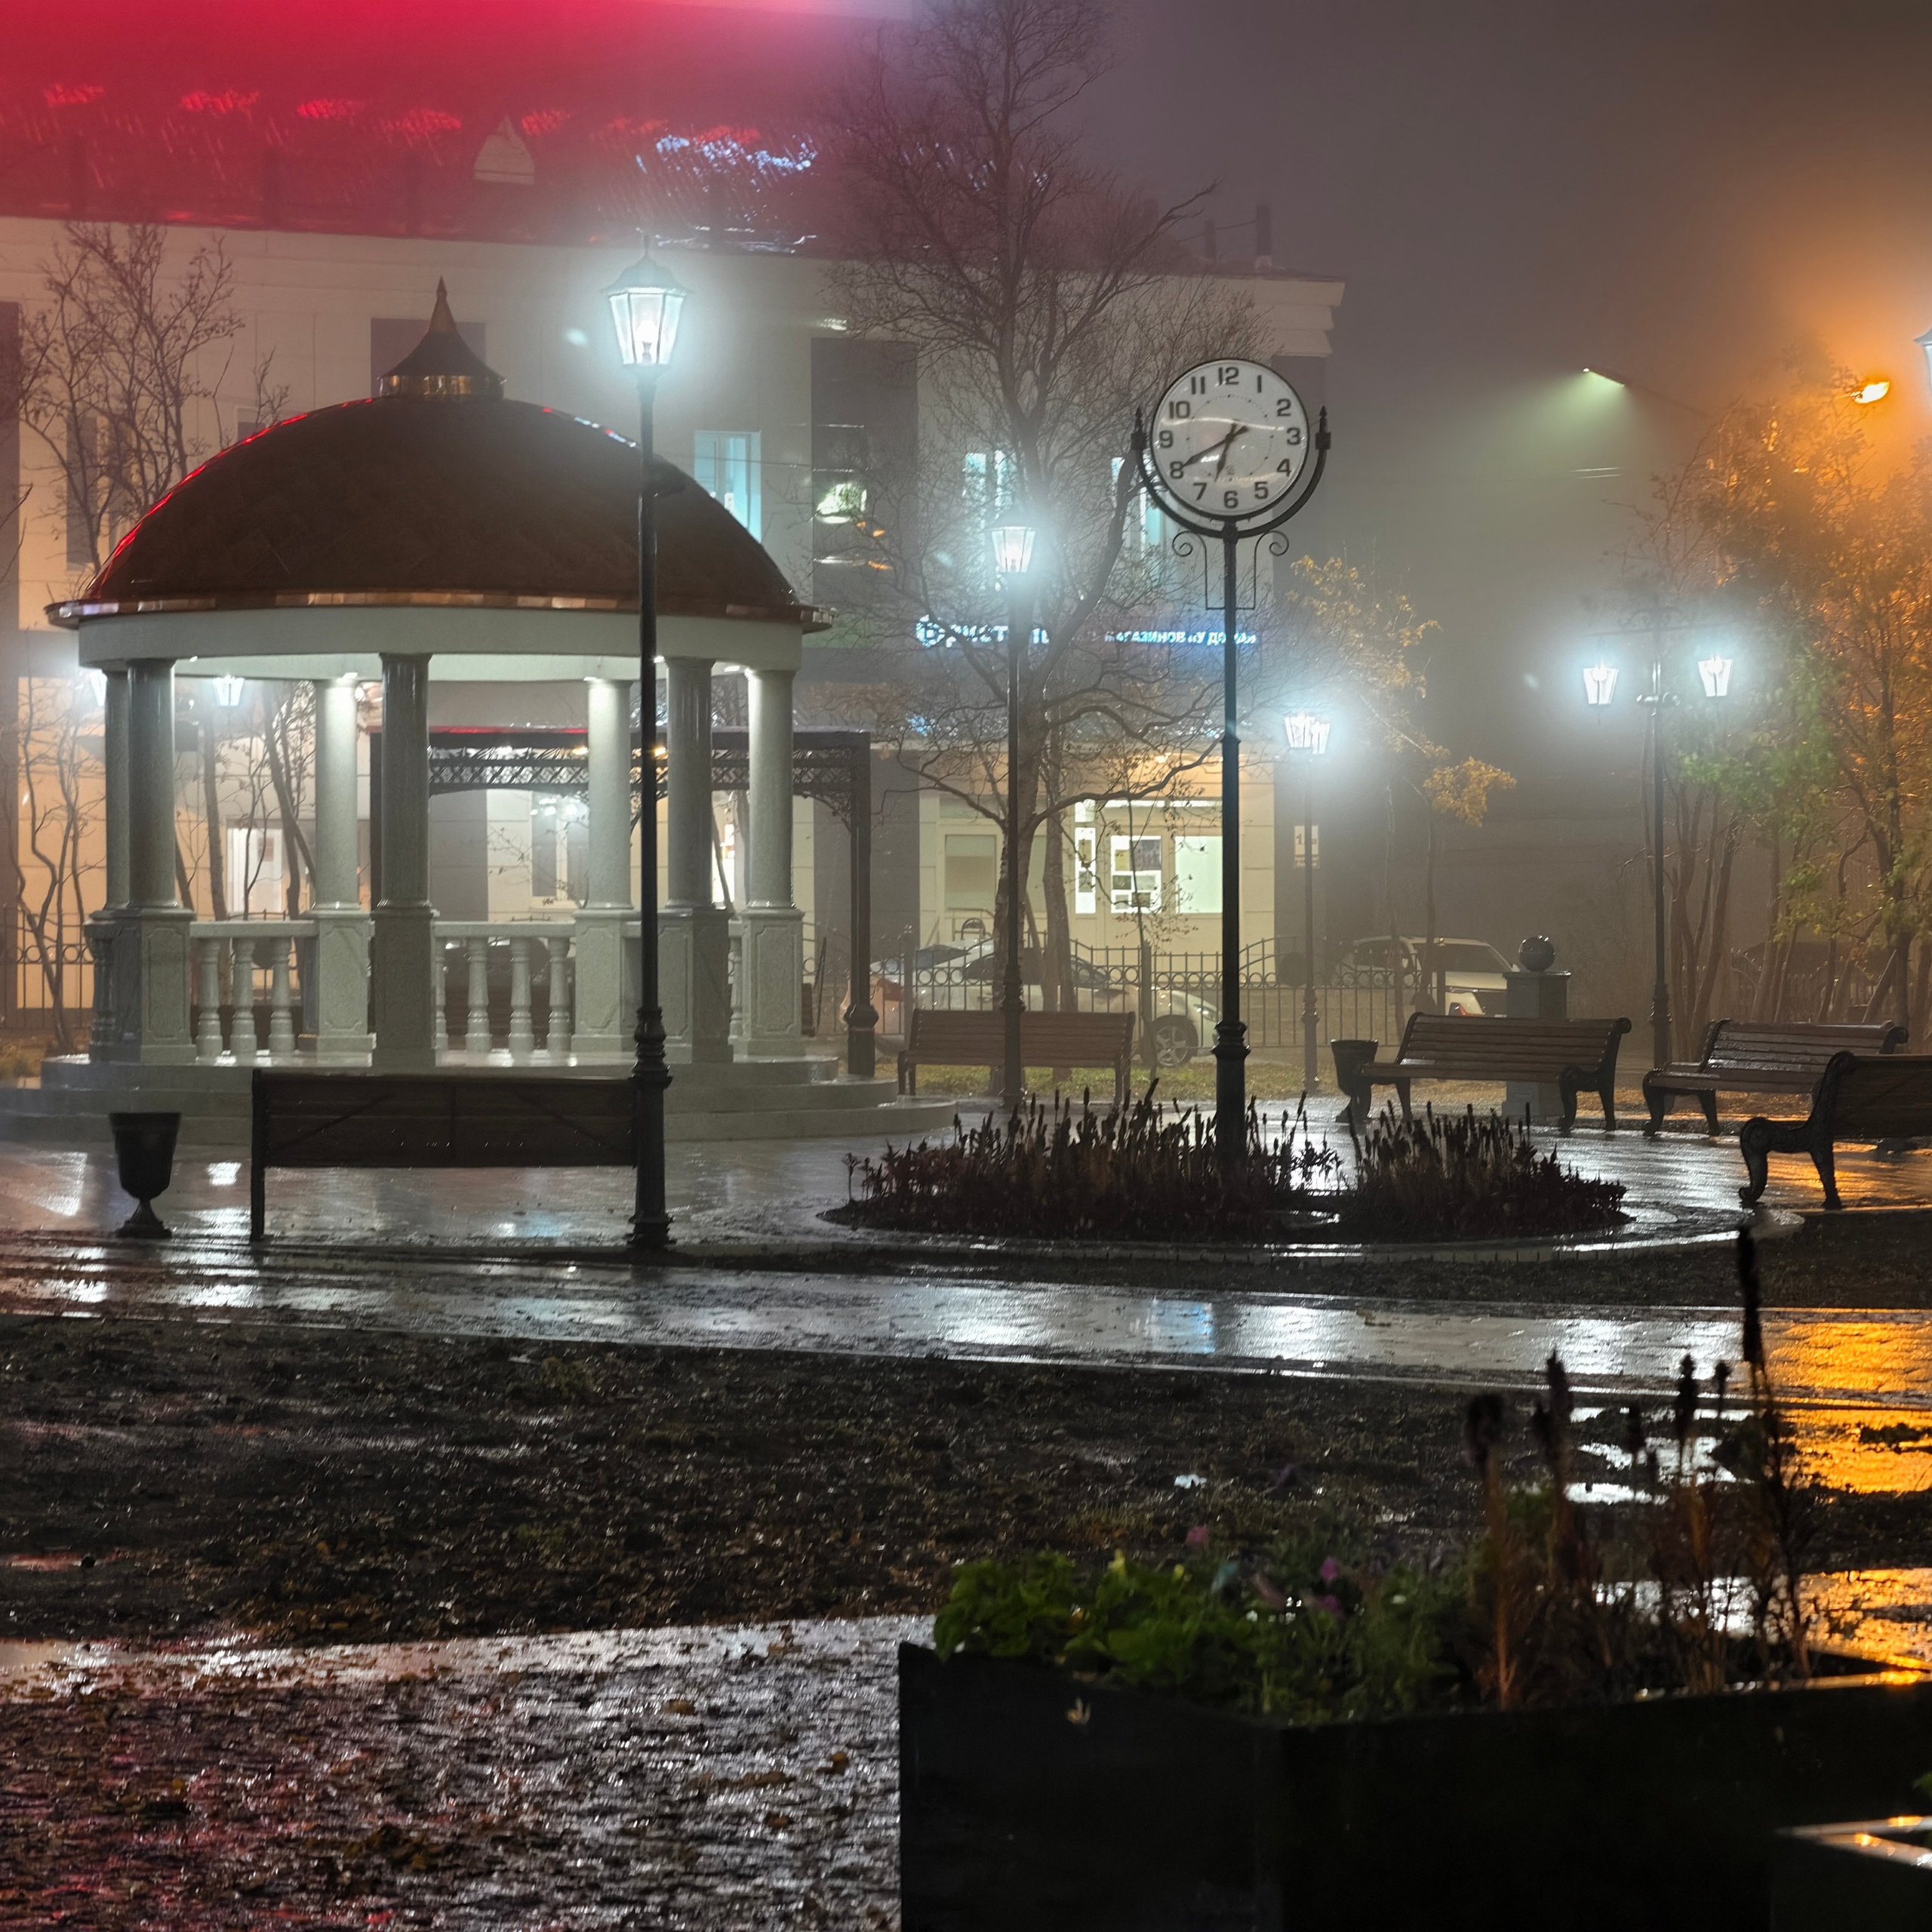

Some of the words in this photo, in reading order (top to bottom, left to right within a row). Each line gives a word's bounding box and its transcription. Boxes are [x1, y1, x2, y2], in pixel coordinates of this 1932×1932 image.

[1218, 367, 1239, 385] 12
[1257, 375, 1262, 392] 1
[1191, 377, 1205, 394] 11
[1169, 401, 1190, 419] 10
[1276, 398, 1291, 417] 2
[1159, 430, 1174, 448] 9
[1287, 428, 1301, 445] 3
[1170, 461, 1184, 479] 8
[1277, 459, 1291, 477] 4
[1193, 482, 1207, 500] 7
[1254, 481, 1269, 499] 5
[1224, 491, 1238, 509] 6
[1208, 632, 1257, 645] ДОА»
